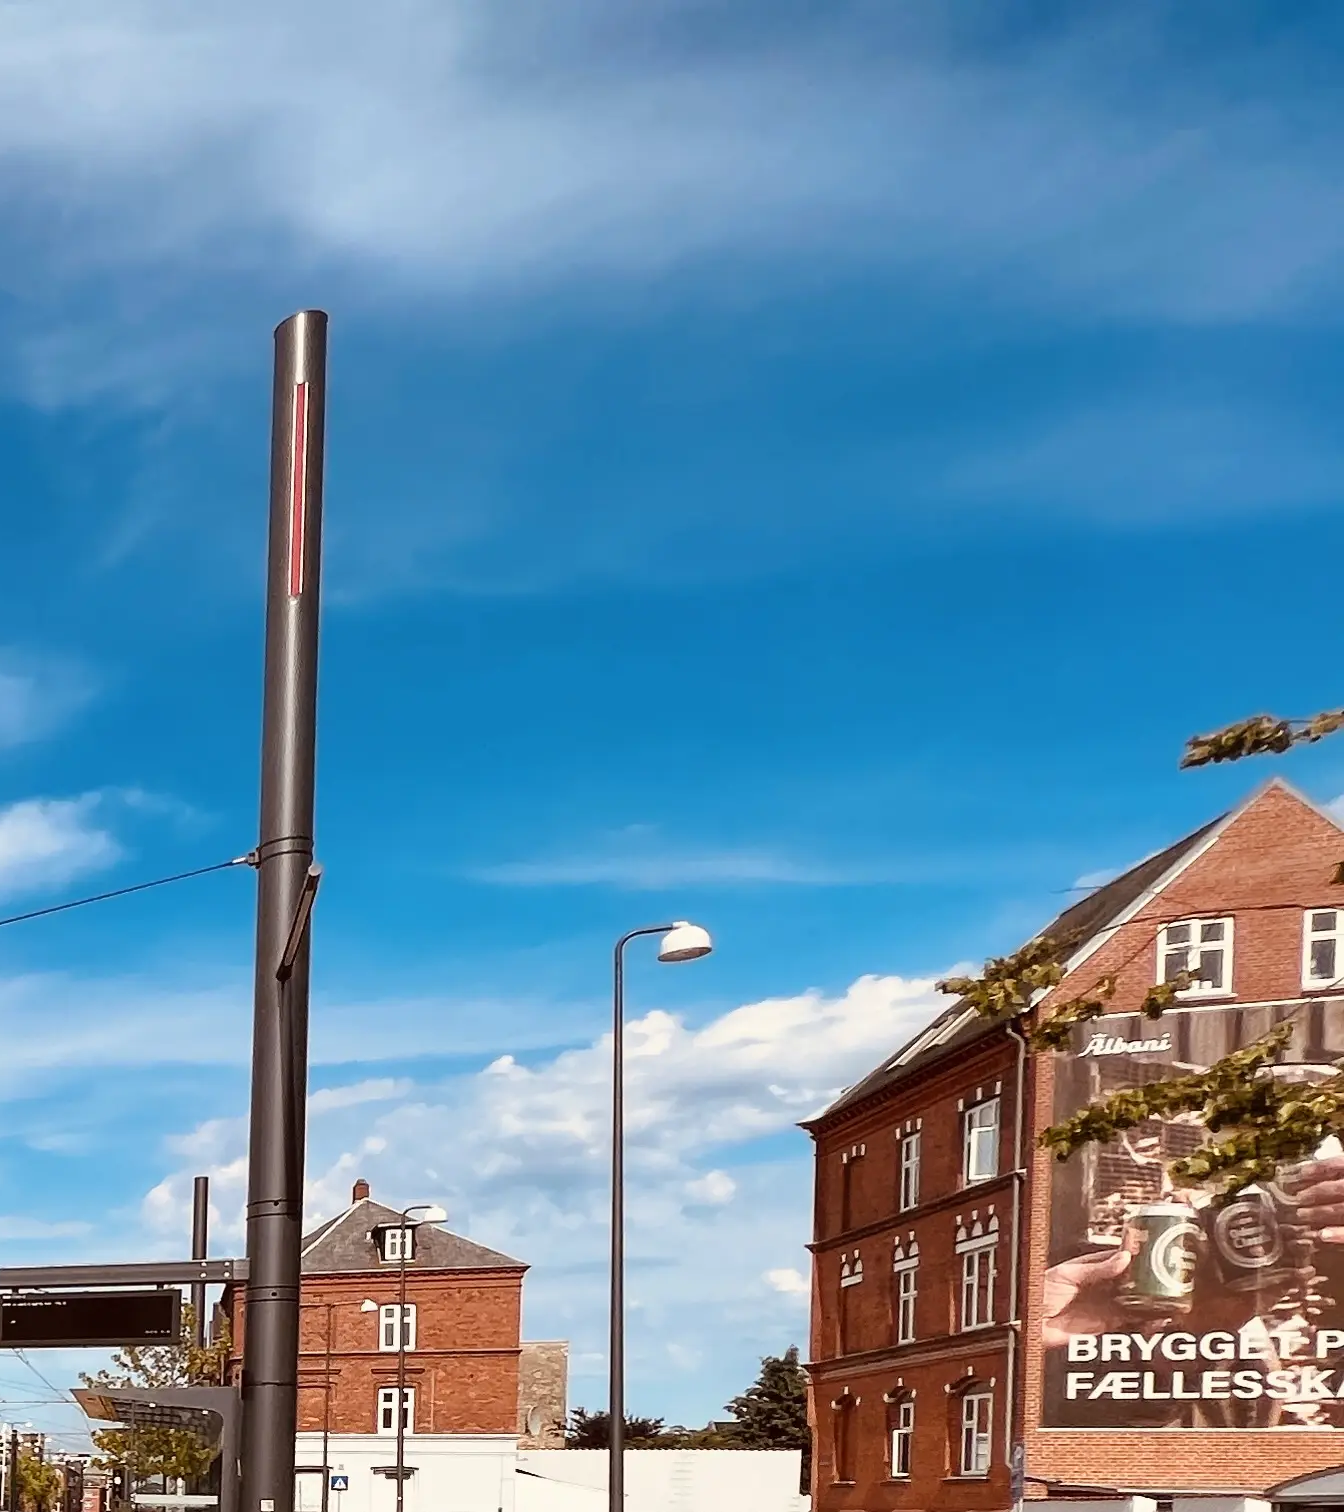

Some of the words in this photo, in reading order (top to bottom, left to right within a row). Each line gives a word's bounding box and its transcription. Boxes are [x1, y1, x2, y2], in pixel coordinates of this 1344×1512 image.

[1067, 1330, 1307, 1363] BRYGGET
[1316, 1329, 1344, 1359] P
[1065, 1369, 1344, 1400] FÆLLESSK
